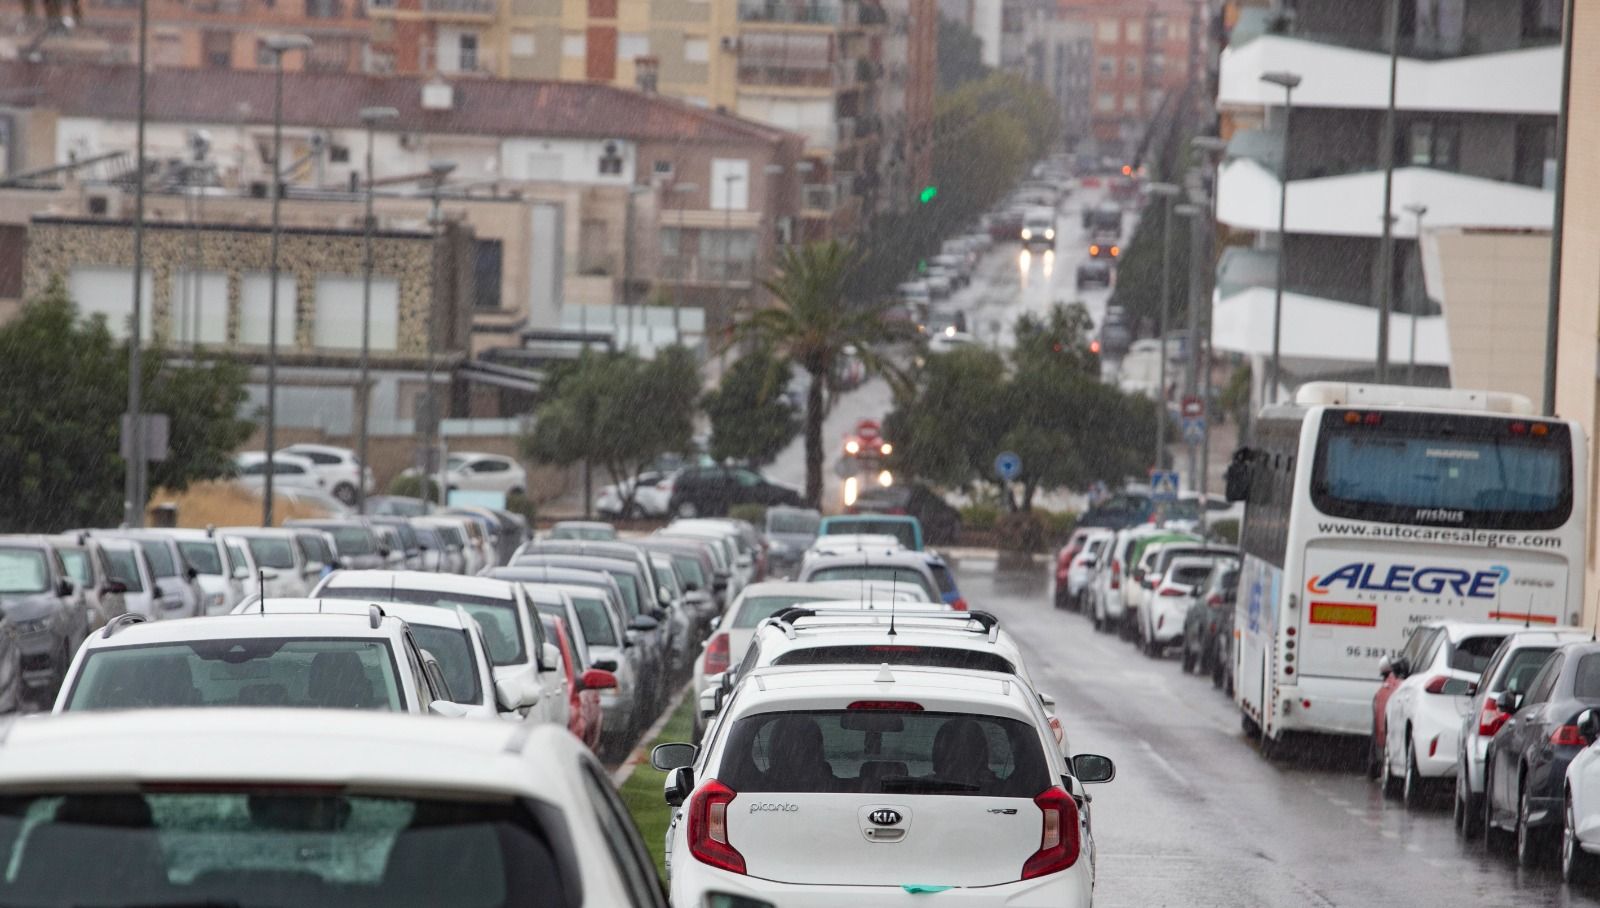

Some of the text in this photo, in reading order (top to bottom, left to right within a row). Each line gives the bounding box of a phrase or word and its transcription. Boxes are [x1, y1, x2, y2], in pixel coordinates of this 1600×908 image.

[1318, 521, 1562, 549] www.autocaresalegre.com
[1317, 562, 1499, 598] ALEGRE
[1356, 592, 1465, 607] AUTOCARES
[1345, 645, 1361, 657] 96
[750, 802, 799, 814] picanto
[873, 811, 897, 823] KIA
